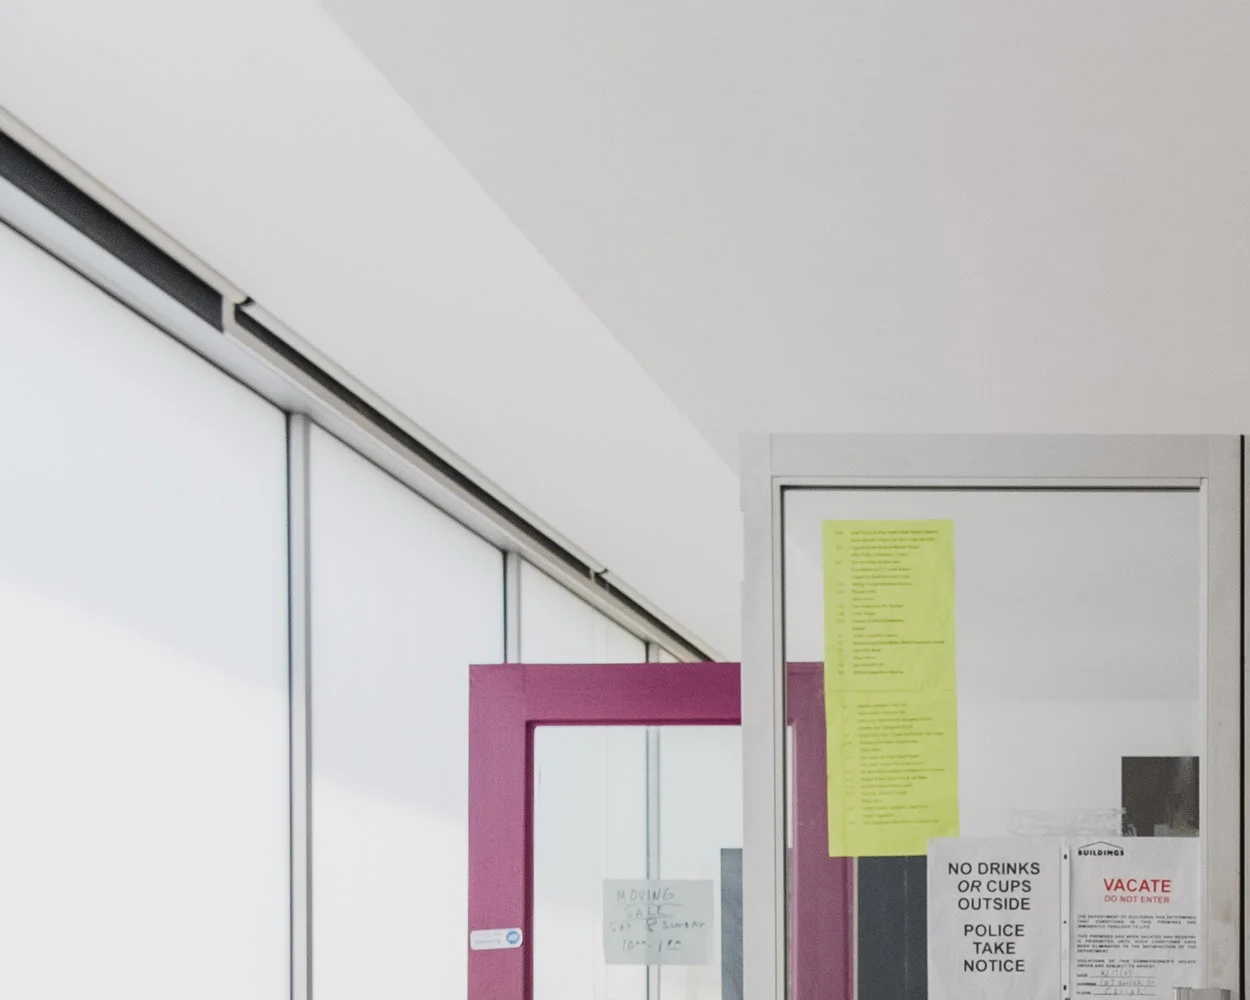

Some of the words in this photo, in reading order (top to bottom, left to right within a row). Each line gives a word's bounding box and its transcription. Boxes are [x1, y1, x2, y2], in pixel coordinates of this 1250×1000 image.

[1078, 849, 1125, 857] BUILDINGS
[948, 862, 973, 876] NO
[977, 862, 1041, 876] DRINKS
[957, 879, 982, 893] OR
[986, 879, 1032, 893] CUPS
[1103, 878, 1172, 894] VACATE
[616, 887, 675, 902] MOVING
[1104, 895, 1118, 903] DO
[1120, 895, 1138, 903] NOT
[1140, 896, 1170, 904] ENTER
[957, 897, 1032, 911] OUTSIDE
[963, 924, 1025, 938] POLICE
[972, 941, 1016, 955] TAKE
[963, 959, 1025, 972] NOTICE
